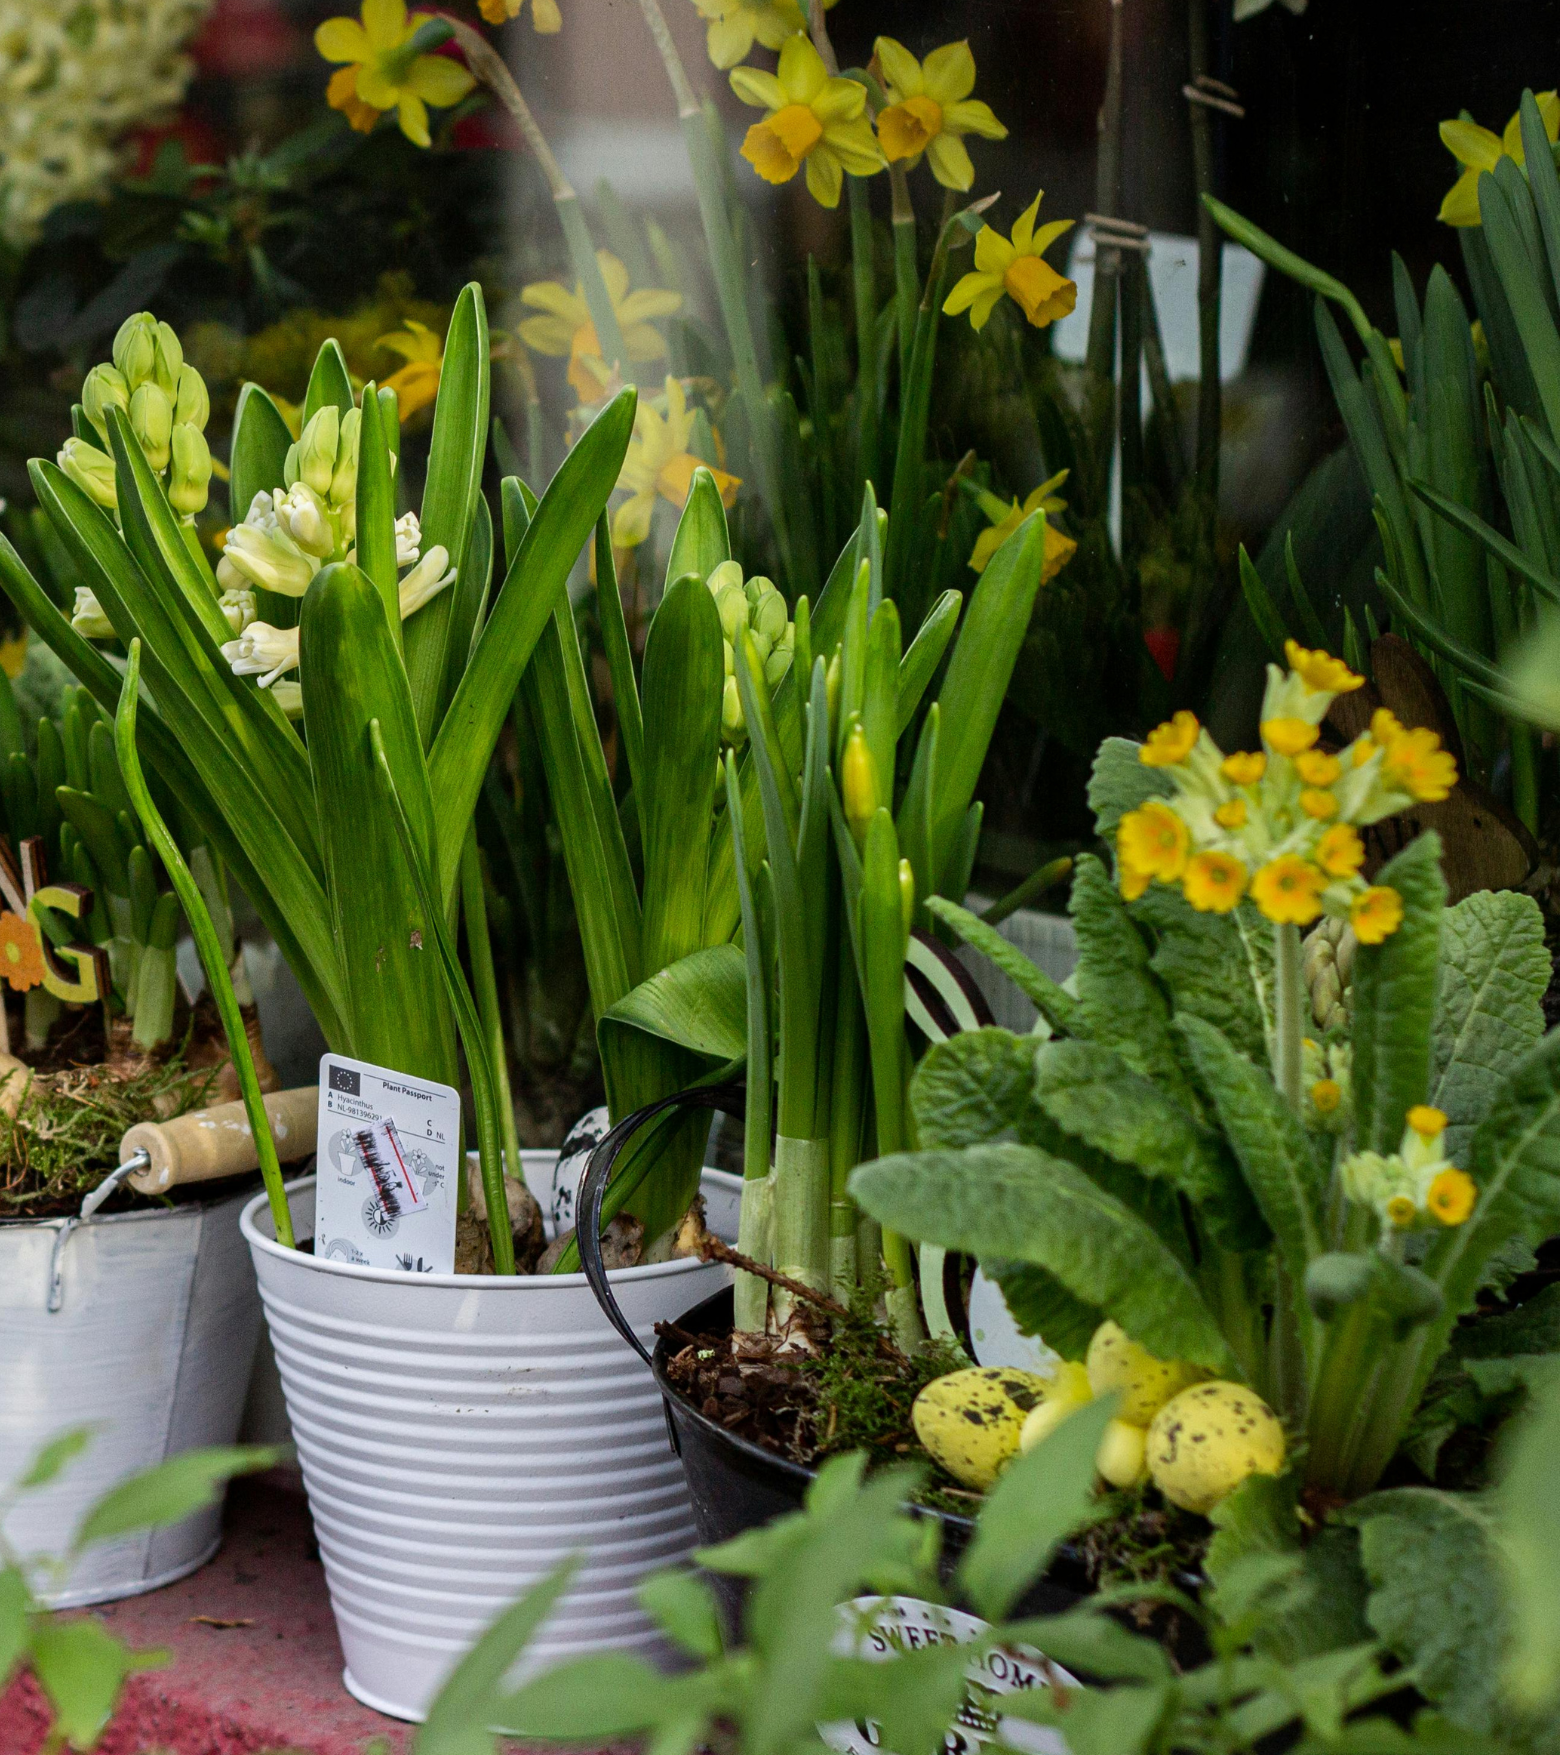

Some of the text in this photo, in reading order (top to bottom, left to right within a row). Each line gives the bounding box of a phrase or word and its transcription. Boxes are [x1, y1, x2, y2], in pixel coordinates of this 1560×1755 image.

[382, 1081, 433, 1102] Plant Passport
[327, 1091, 374, 1110] A Hyacinthus
[327, 1100, 333, 1108] B
[426, 1119, 432, 1127] C
[426, 1128, 445, 1141] D NL
[435, 1164, 445, 1172] not
[337, 1175, 356, 1186] indoor
[428, 1171, 445, 1180] under
[968, 1651, 1052, 1690] OM
